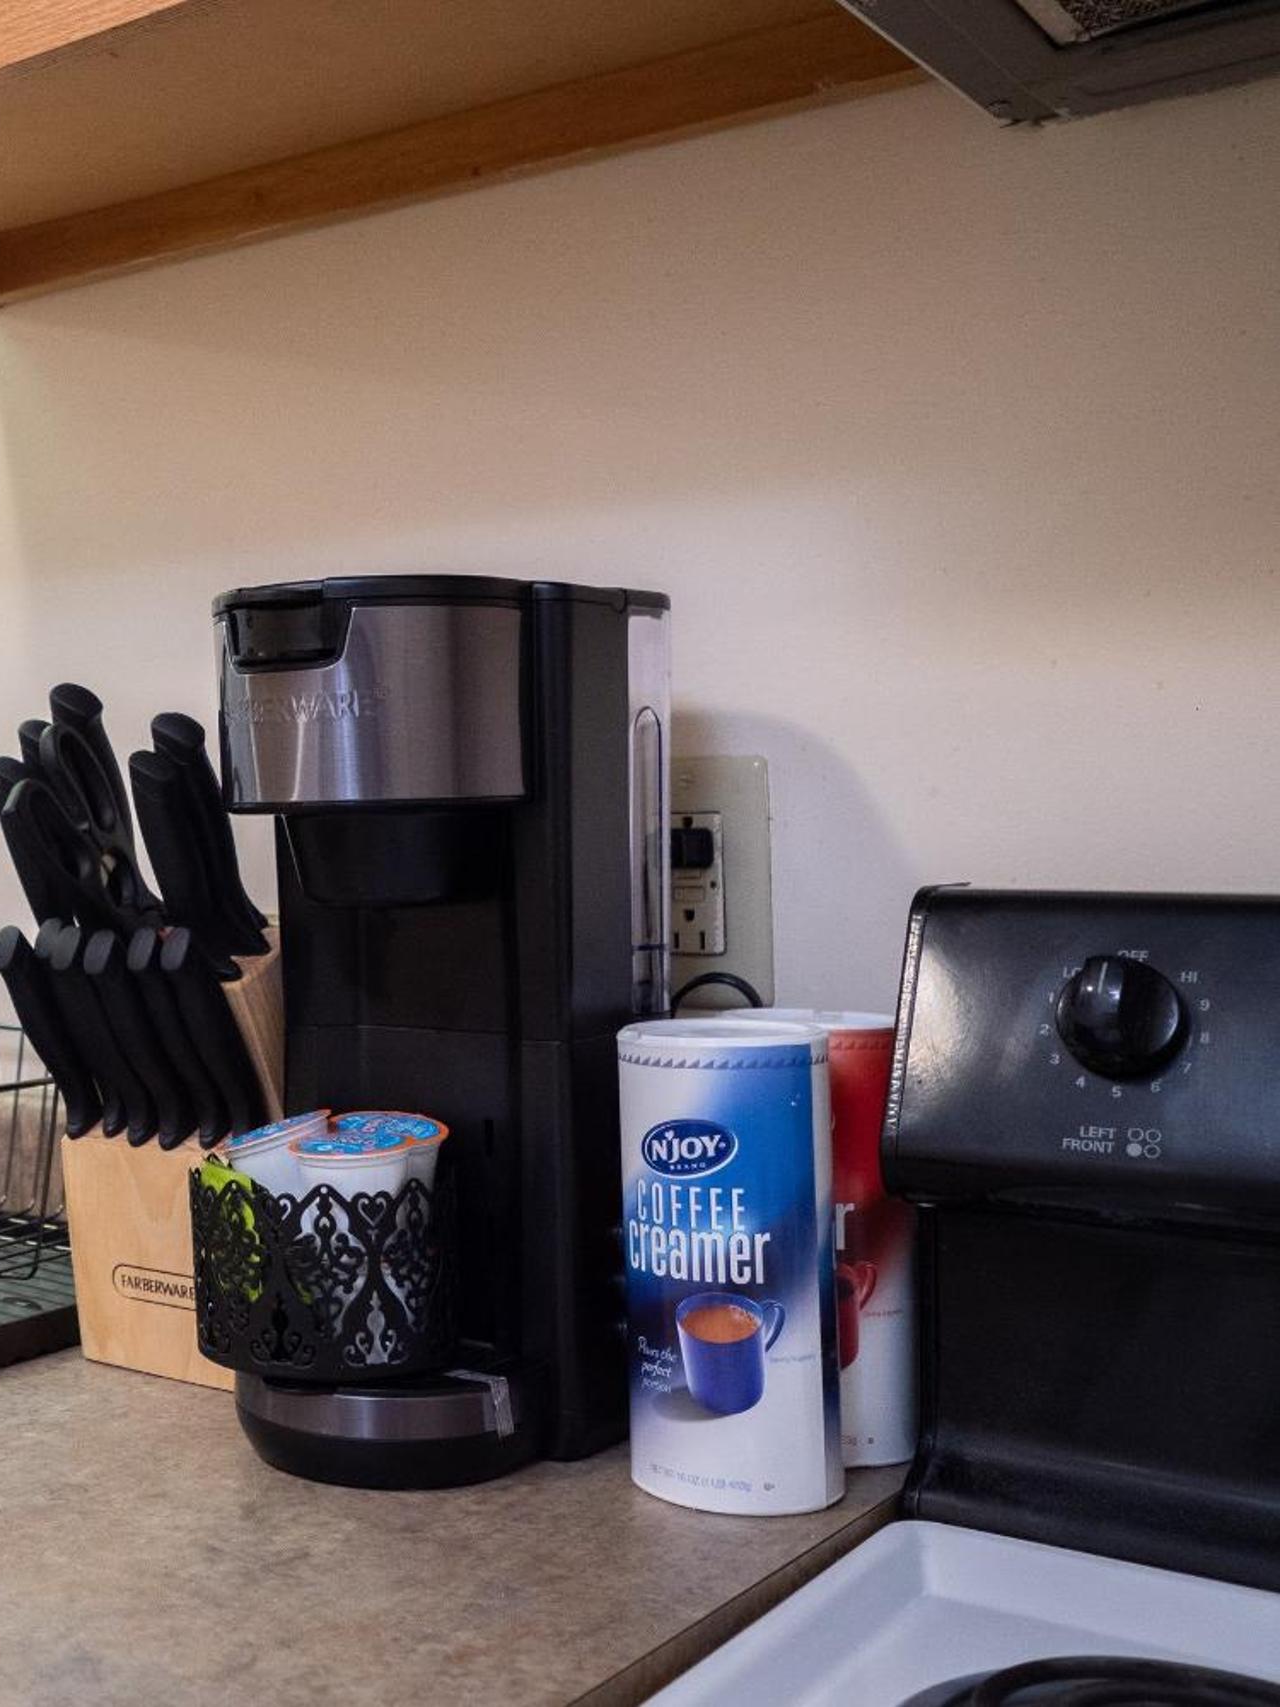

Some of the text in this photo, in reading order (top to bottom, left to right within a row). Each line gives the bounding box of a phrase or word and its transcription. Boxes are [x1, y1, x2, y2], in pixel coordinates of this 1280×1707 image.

[1180, 971, 1197, 983] HI
[1199, 998, 1210, 1011] 9
[1039, 1023, 1050, 1036] 2
[1048, 1053, 1060, 1065] 3
[1075, 1075, 1086, 1088] 4
[1150, 1079, 1162, 1093] 6
[1111, 1085, 1122, 1098] 5
[1079, 1126, 1116, 1139] LEFT
[1062, 1137, 1115, 1153] FRONT
[637, 1179, 746, 1231] COFFEE
[628, 1218, 771, 1285] creamer
